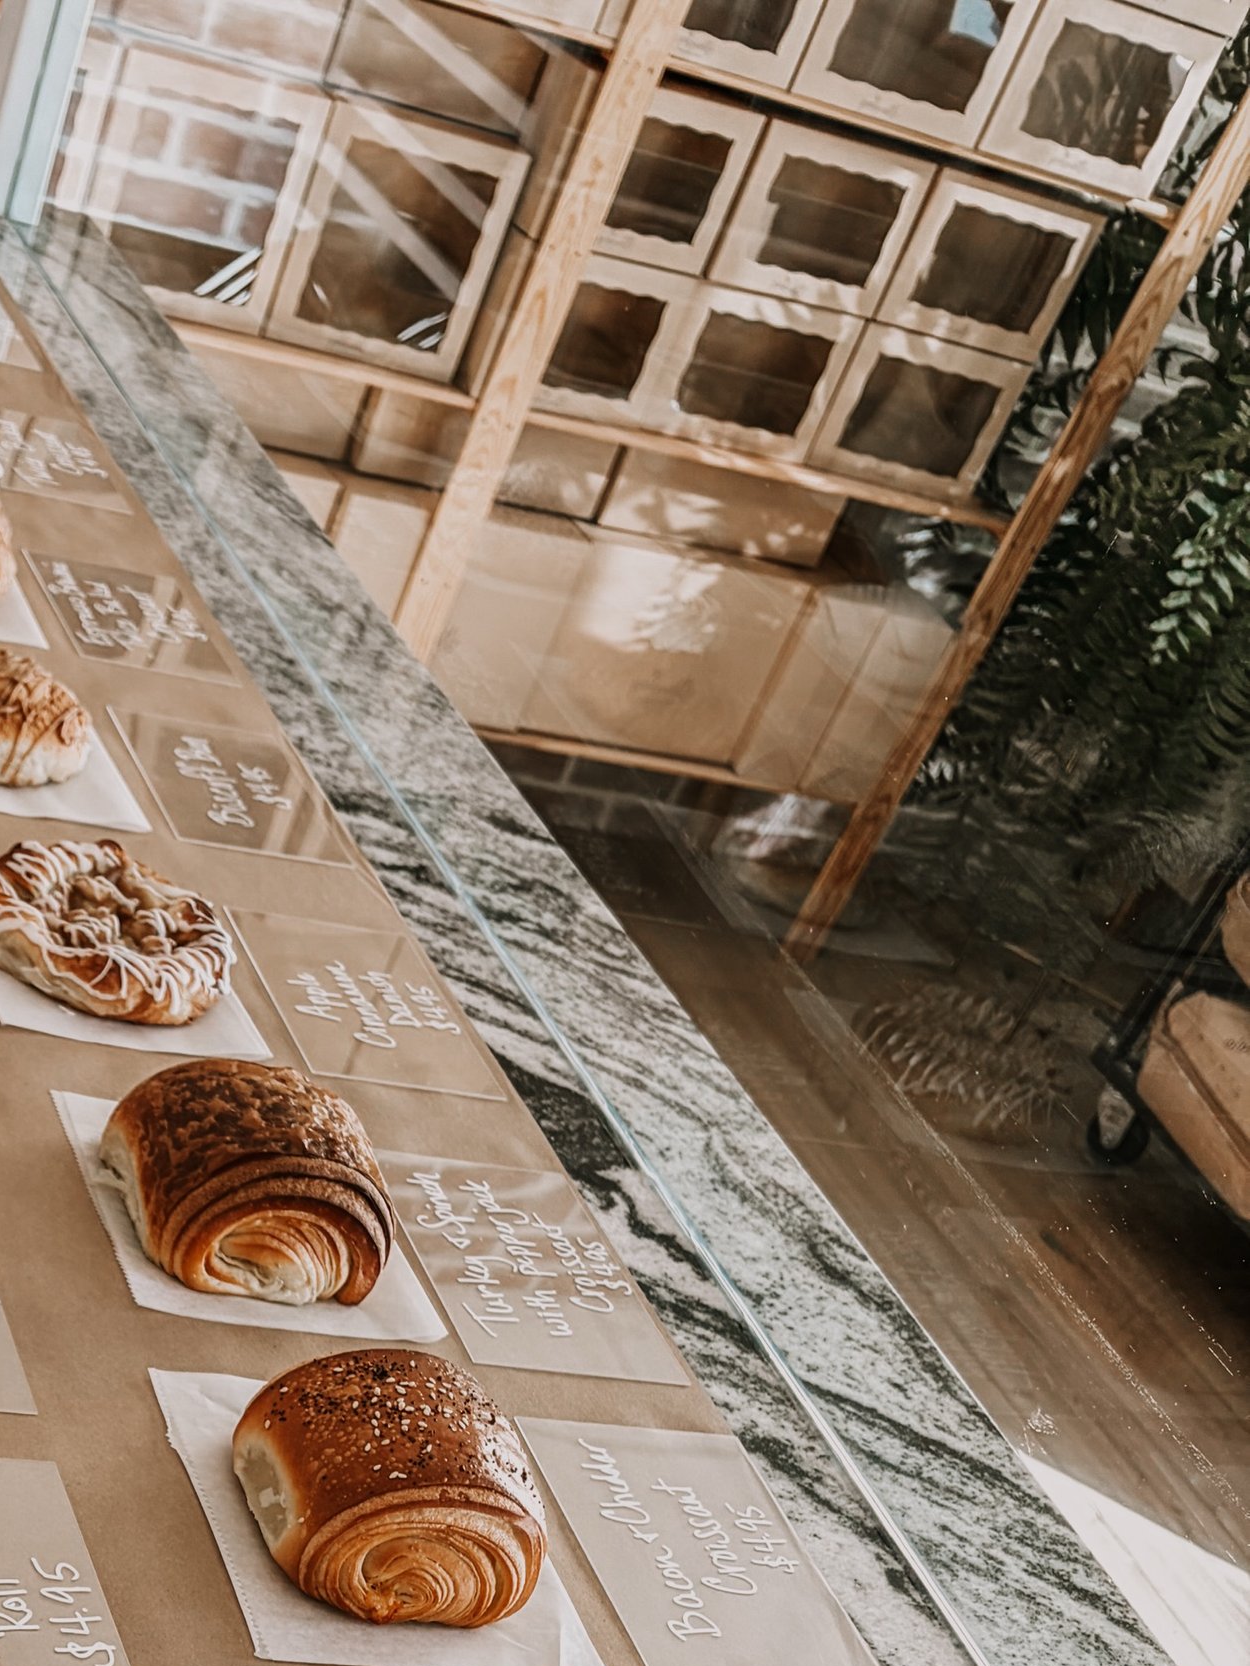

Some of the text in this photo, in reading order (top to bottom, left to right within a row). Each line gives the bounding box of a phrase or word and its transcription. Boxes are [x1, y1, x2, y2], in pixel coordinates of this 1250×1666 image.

[287, 971, 350, 1023] Apple
[325, 960, 397, 1049] Cinnamon
[358, 970, 423, 1029] Danish
[405, 1171, 476, 1234] Spinach
[457, 1255, 520, 1339] Turkey
[532, 1212, 614, 1313] Croissant
[522, 1290, 573, 1338] with
[577, 1437, 650, 1525] Cheddar
[651, 1477, 758, 1595] Croissant
[725, 1502, 800, 1574] $4.95
[655, 1544, 722, 1642] Bacon
